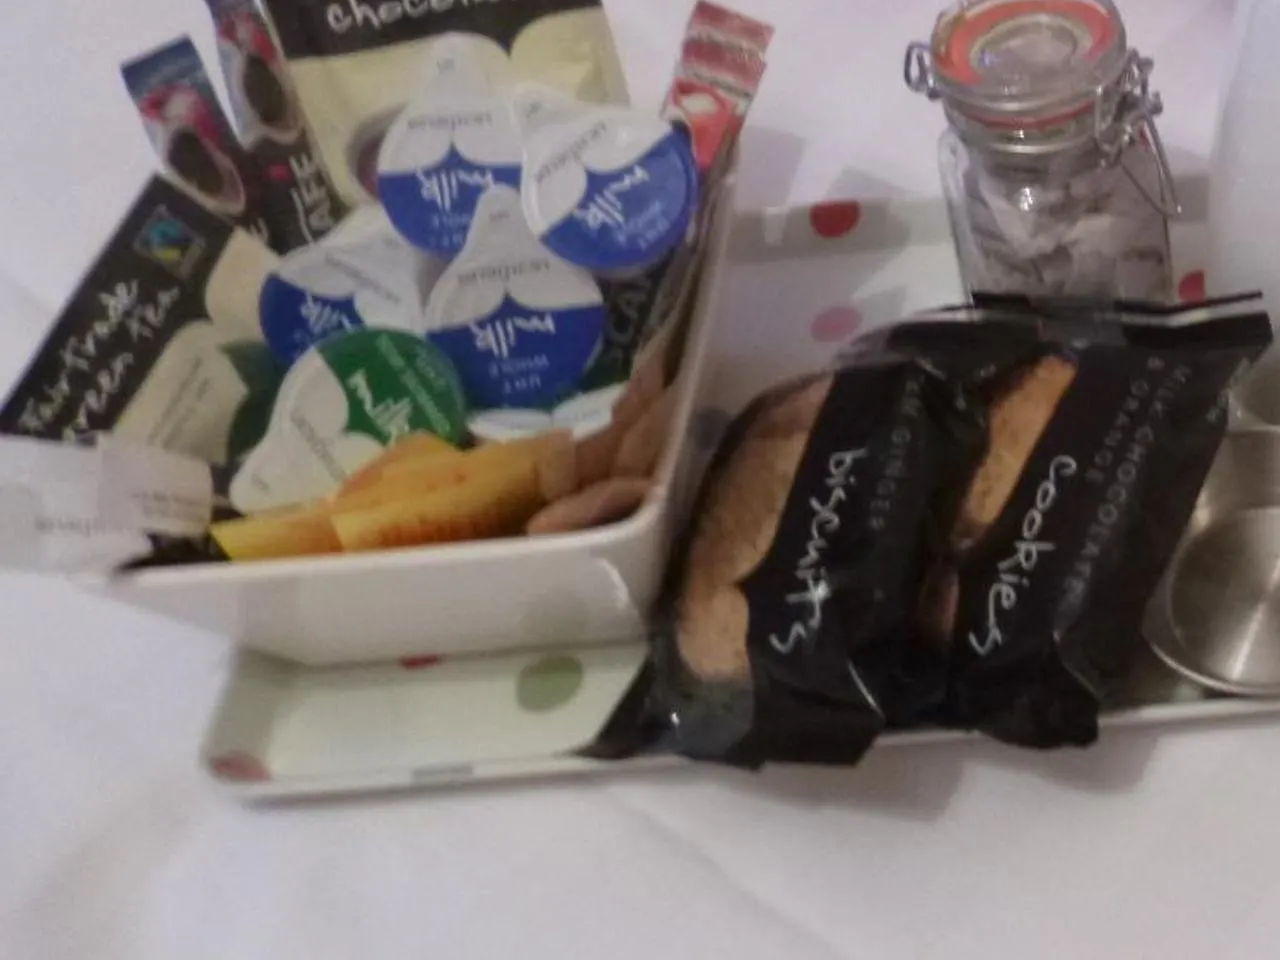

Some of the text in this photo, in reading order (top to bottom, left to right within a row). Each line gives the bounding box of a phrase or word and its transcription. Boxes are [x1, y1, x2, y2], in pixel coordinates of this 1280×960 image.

[413, 167, 497, 212] milk
[571, 163, 651, 231] milk
[123, 286, 182, 342] tea
[467, 311, 556, 361] milk
[768, 446, 869, 655] biscuits
[967, 453, 1078, 656] cookies
